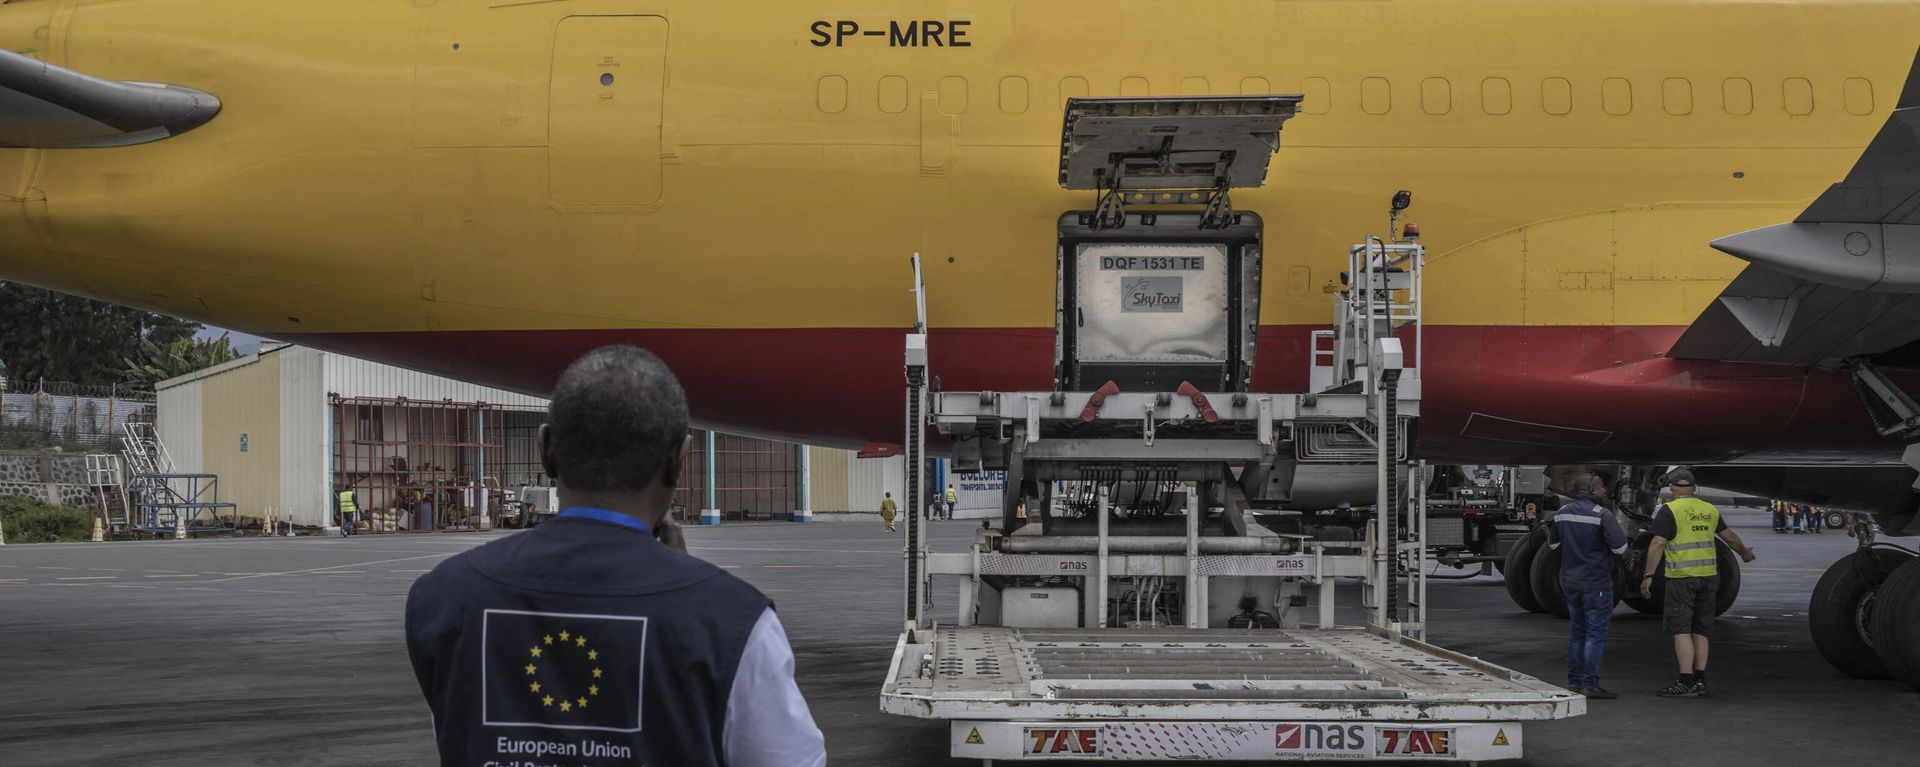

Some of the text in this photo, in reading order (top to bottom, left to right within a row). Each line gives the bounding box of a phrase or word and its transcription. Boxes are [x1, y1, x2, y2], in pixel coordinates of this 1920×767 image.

[810, 20, 971, 47] SP-MRE
[1103, 257, 1201, 270] DQF 1531 TE
[1132, 293, 1181, 308] SkyTaxi
[1068, 561, 1088, 570] nas
[1285, 560, 1304, 569] nas
[1030, 730, 1097, 753] TAE
[1304, 724, 1365, 750] nas
[497, 736, 631, 759] European Union
